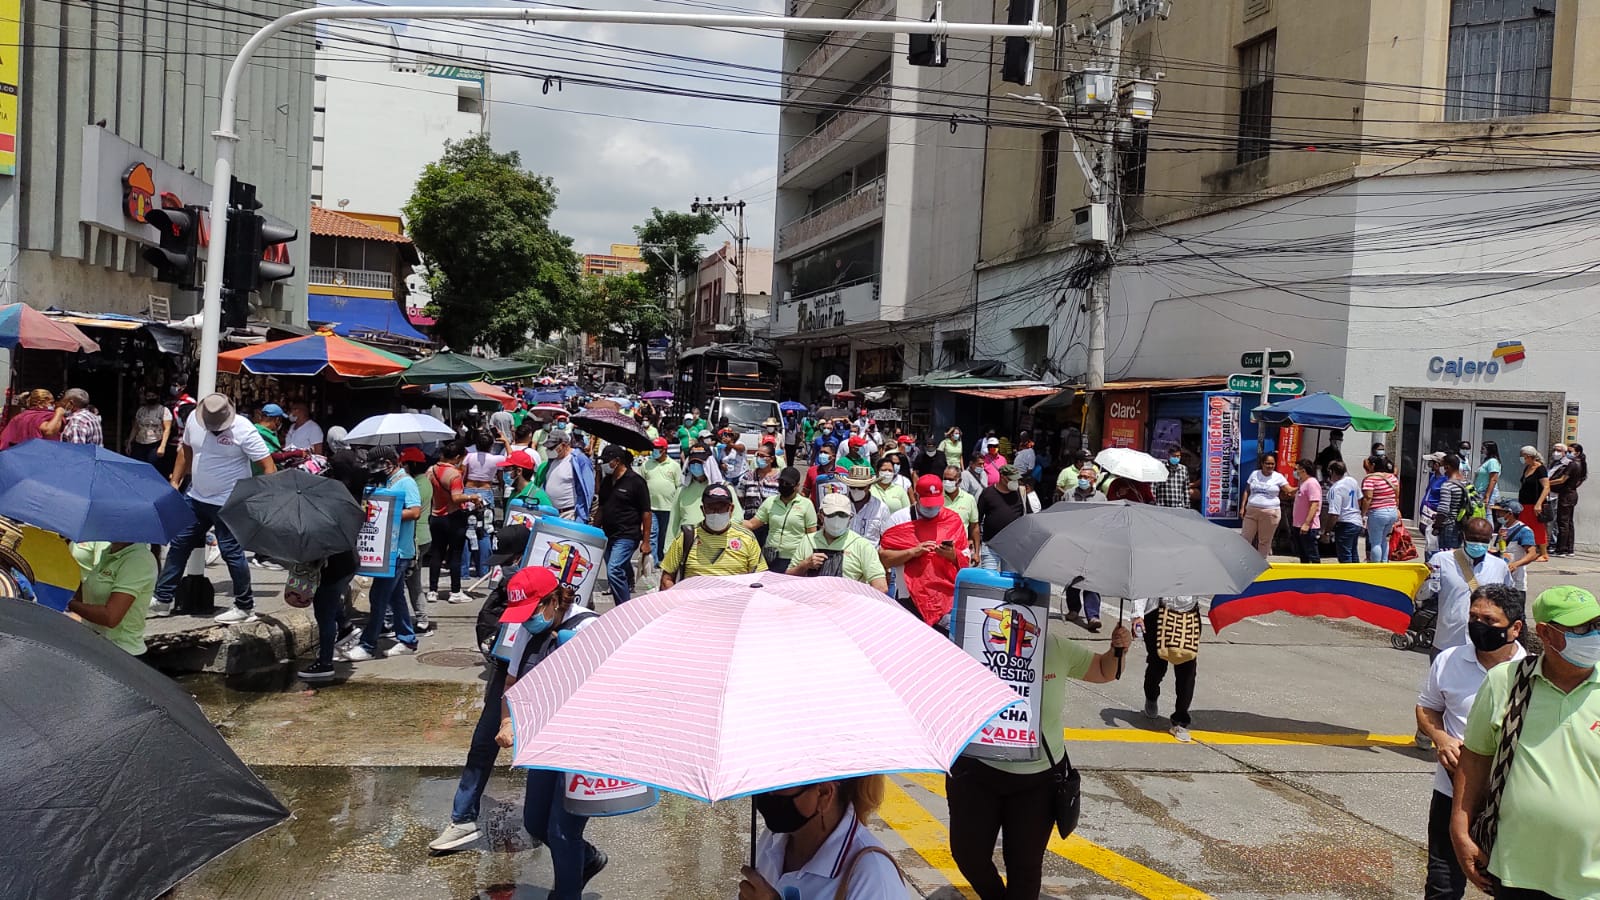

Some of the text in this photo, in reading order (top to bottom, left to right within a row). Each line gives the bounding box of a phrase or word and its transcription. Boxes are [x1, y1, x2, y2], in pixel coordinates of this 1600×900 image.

[1429, 356, 1499, 378] Cajero
[1231, 378, 1248, 387] Calle
[1110, 402, 1136, 419] Claro
[1223, 411, 1231, 438] TABLET
[1222, 445, 1230, 488] CELULARES
[1209, 456, 1222, 514] SERVICIO
[1222, 490, 1229, 500] DE
[987, 652, 1030, 669] YO SOY
[992, 667, 1034, 681] AESTRO
